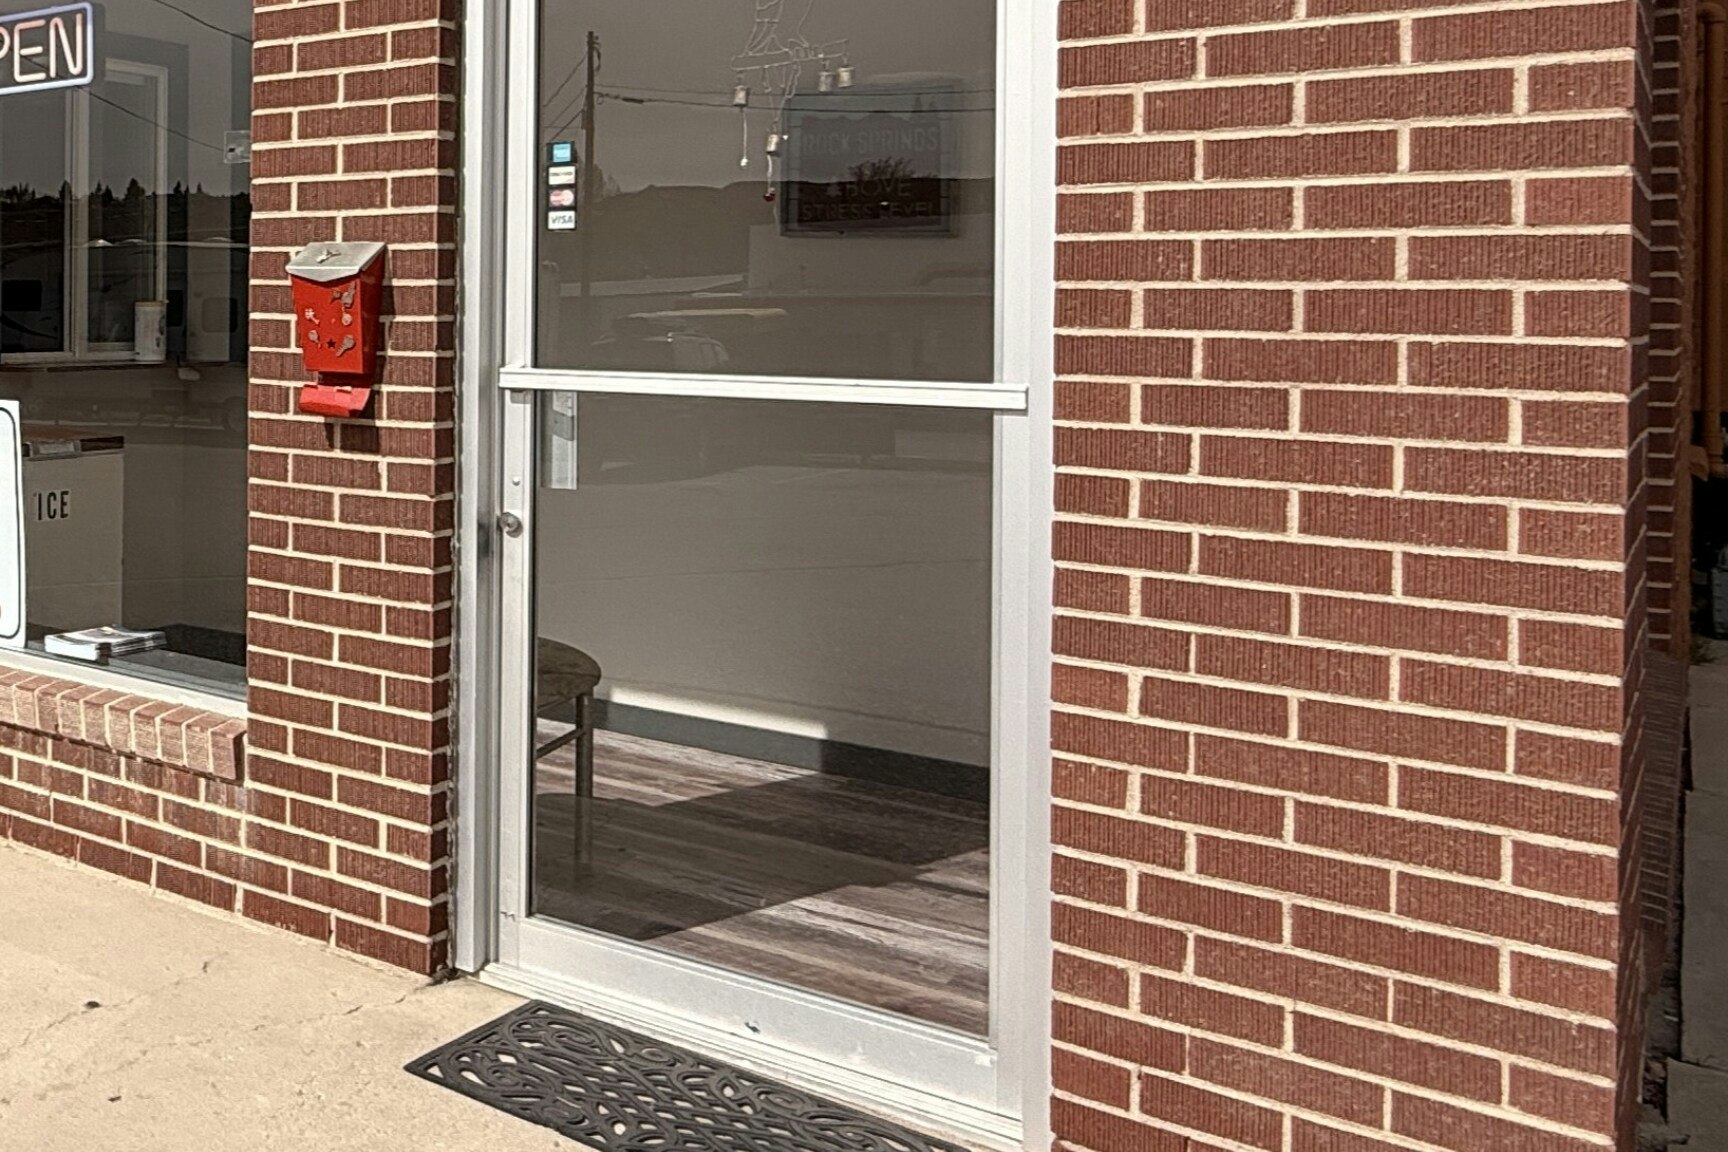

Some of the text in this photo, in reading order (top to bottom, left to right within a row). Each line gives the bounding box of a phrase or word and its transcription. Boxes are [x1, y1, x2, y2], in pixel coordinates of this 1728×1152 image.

[858, 127, 937, 155] SPRINGS
[551, 215, 573, 225] VISA
[803, 203, 874, 221] STRESS
[37, 490, 70, 521] ICE
